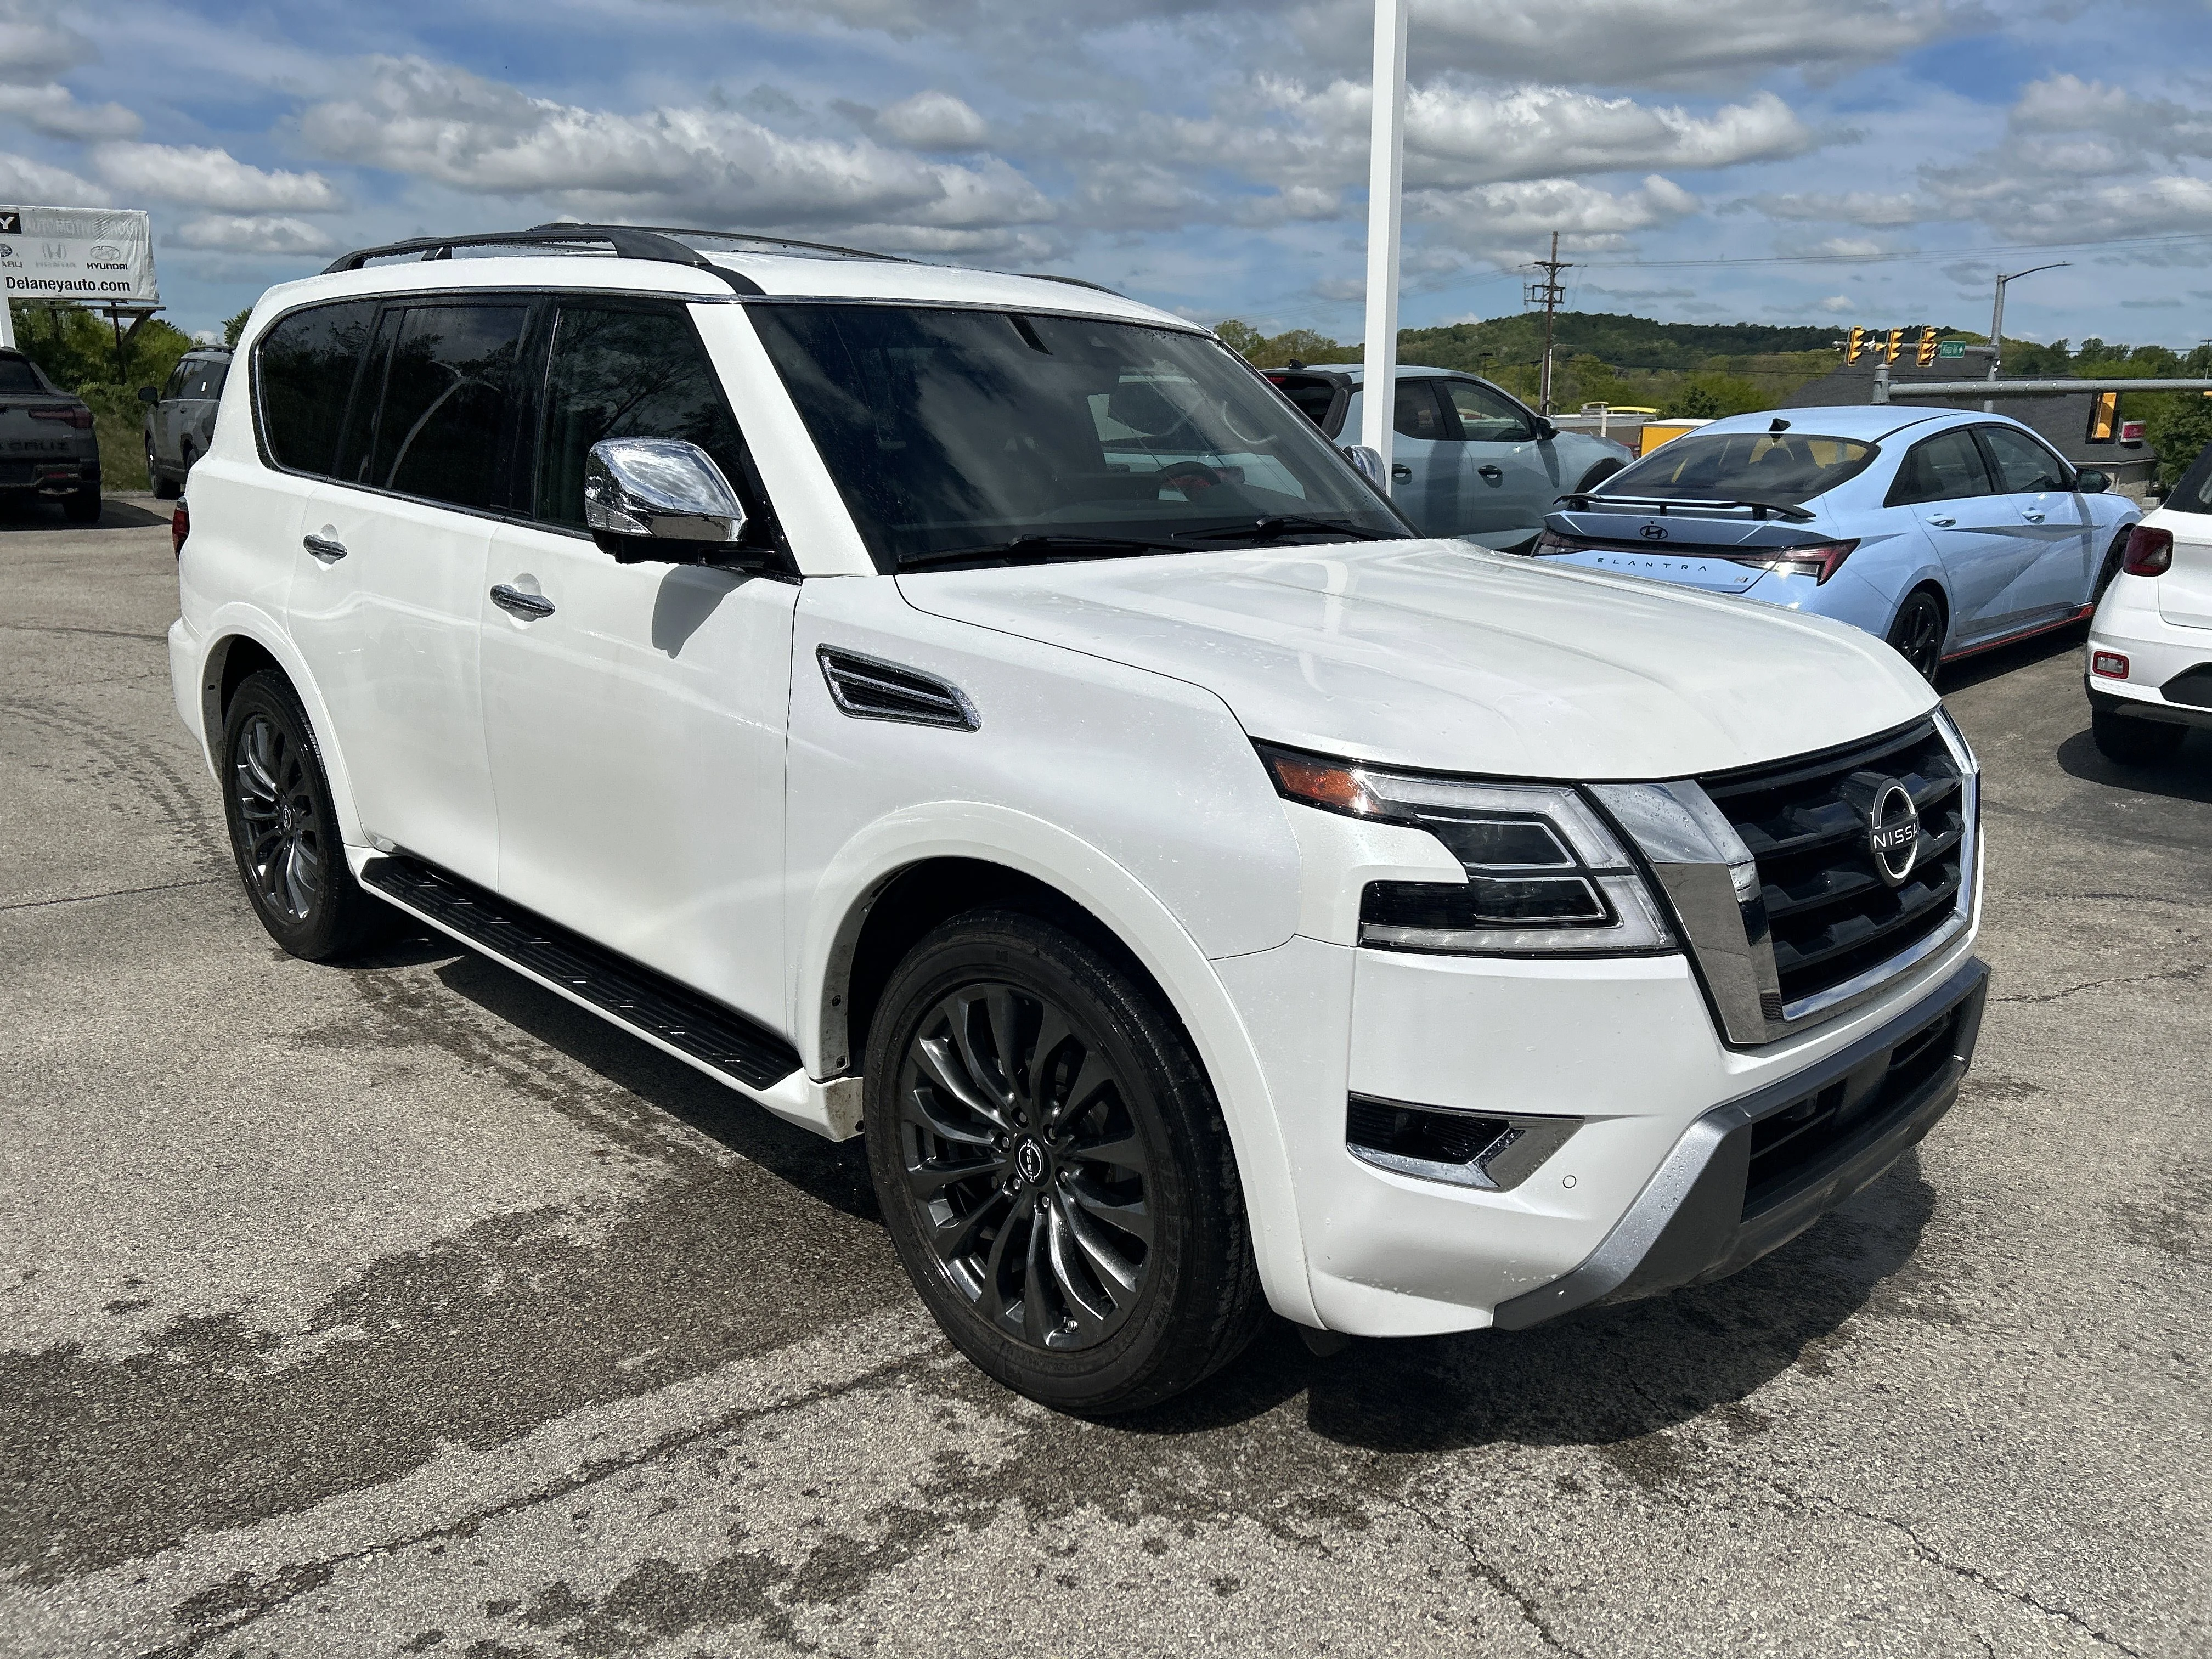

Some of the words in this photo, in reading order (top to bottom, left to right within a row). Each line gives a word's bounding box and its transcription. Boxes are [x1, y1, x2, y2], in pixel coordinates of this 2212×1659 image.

[5, 276, 131, 292] Delaneyauto.com
[1597, 557, 1707, 571] ELANTRA
[1872, 822, 1919, 849] NISSA
[1026, 1139, 1035, 1183] NISSAN
